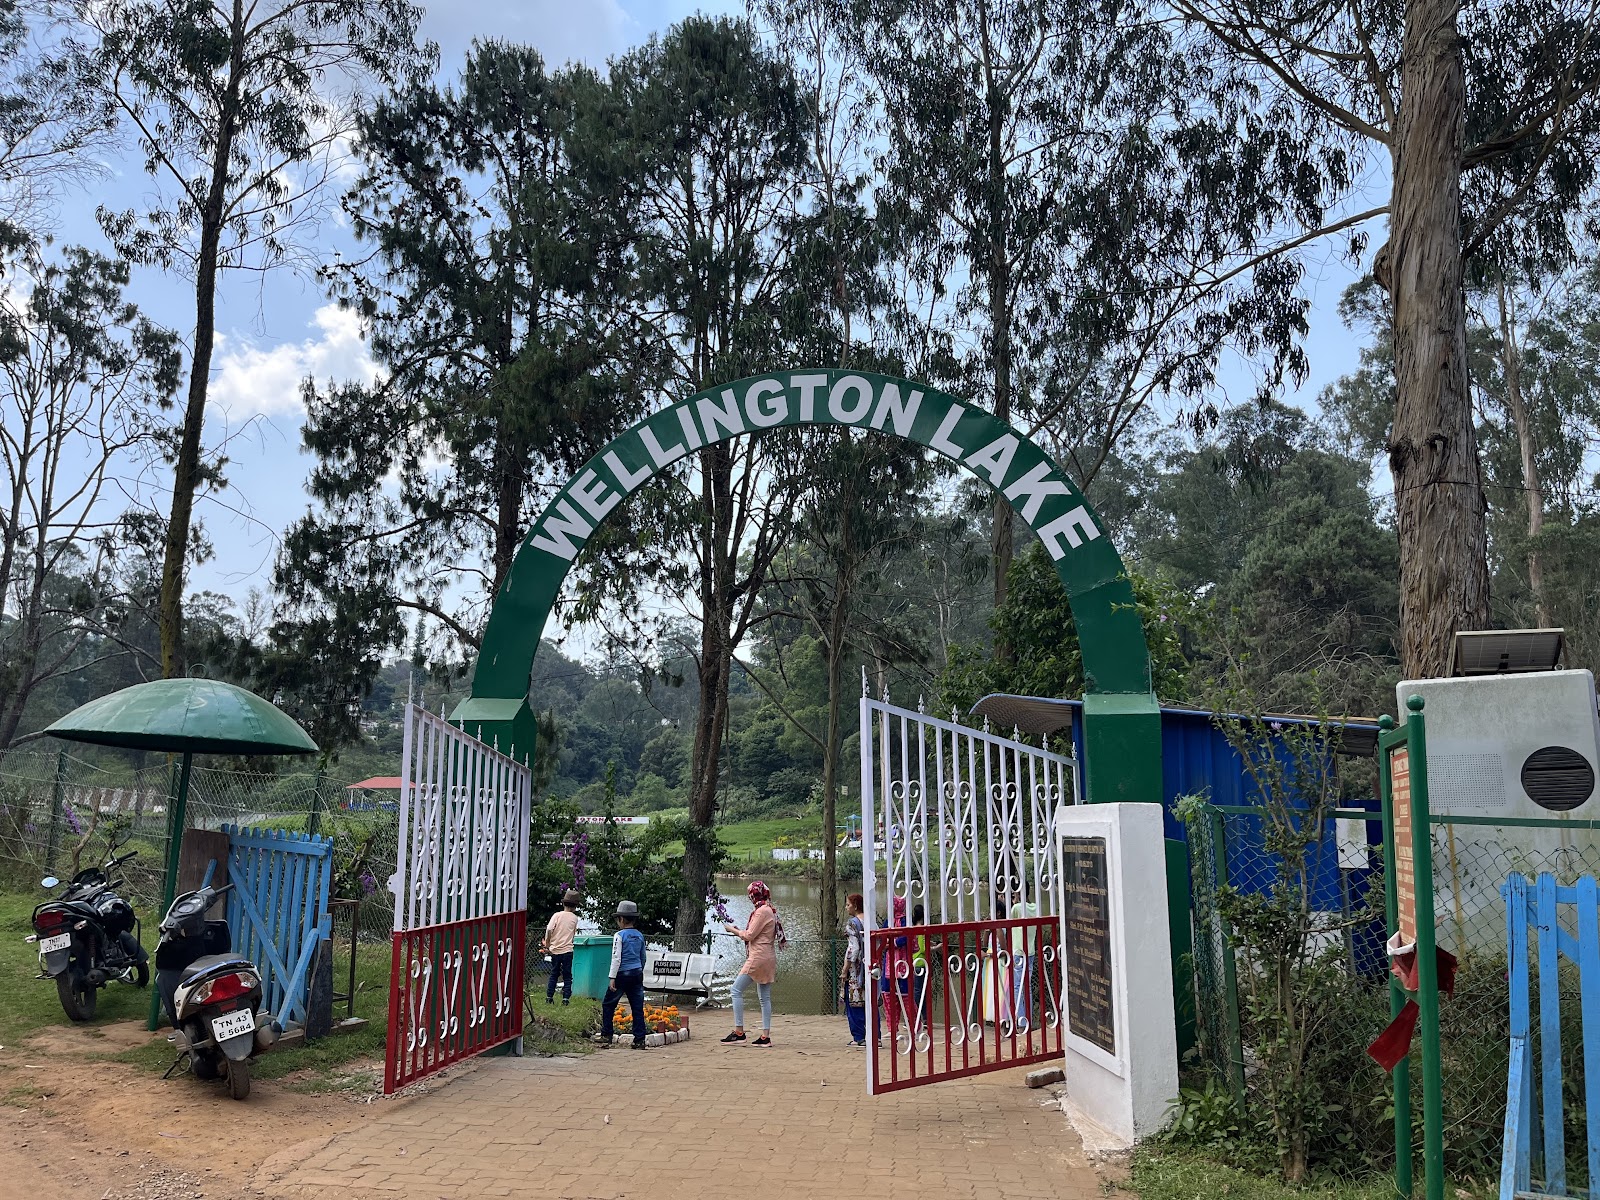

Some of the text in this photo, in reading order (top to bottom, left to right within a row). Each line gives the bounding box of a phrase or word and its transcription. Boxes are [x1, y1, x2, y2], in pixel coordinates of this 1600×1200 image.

[530, 374, 1102, 562] WELLINGTON LAKE
[219, 1014, 247, 1028] TN 43
[219, 1023, 251, 1039] E 5684
